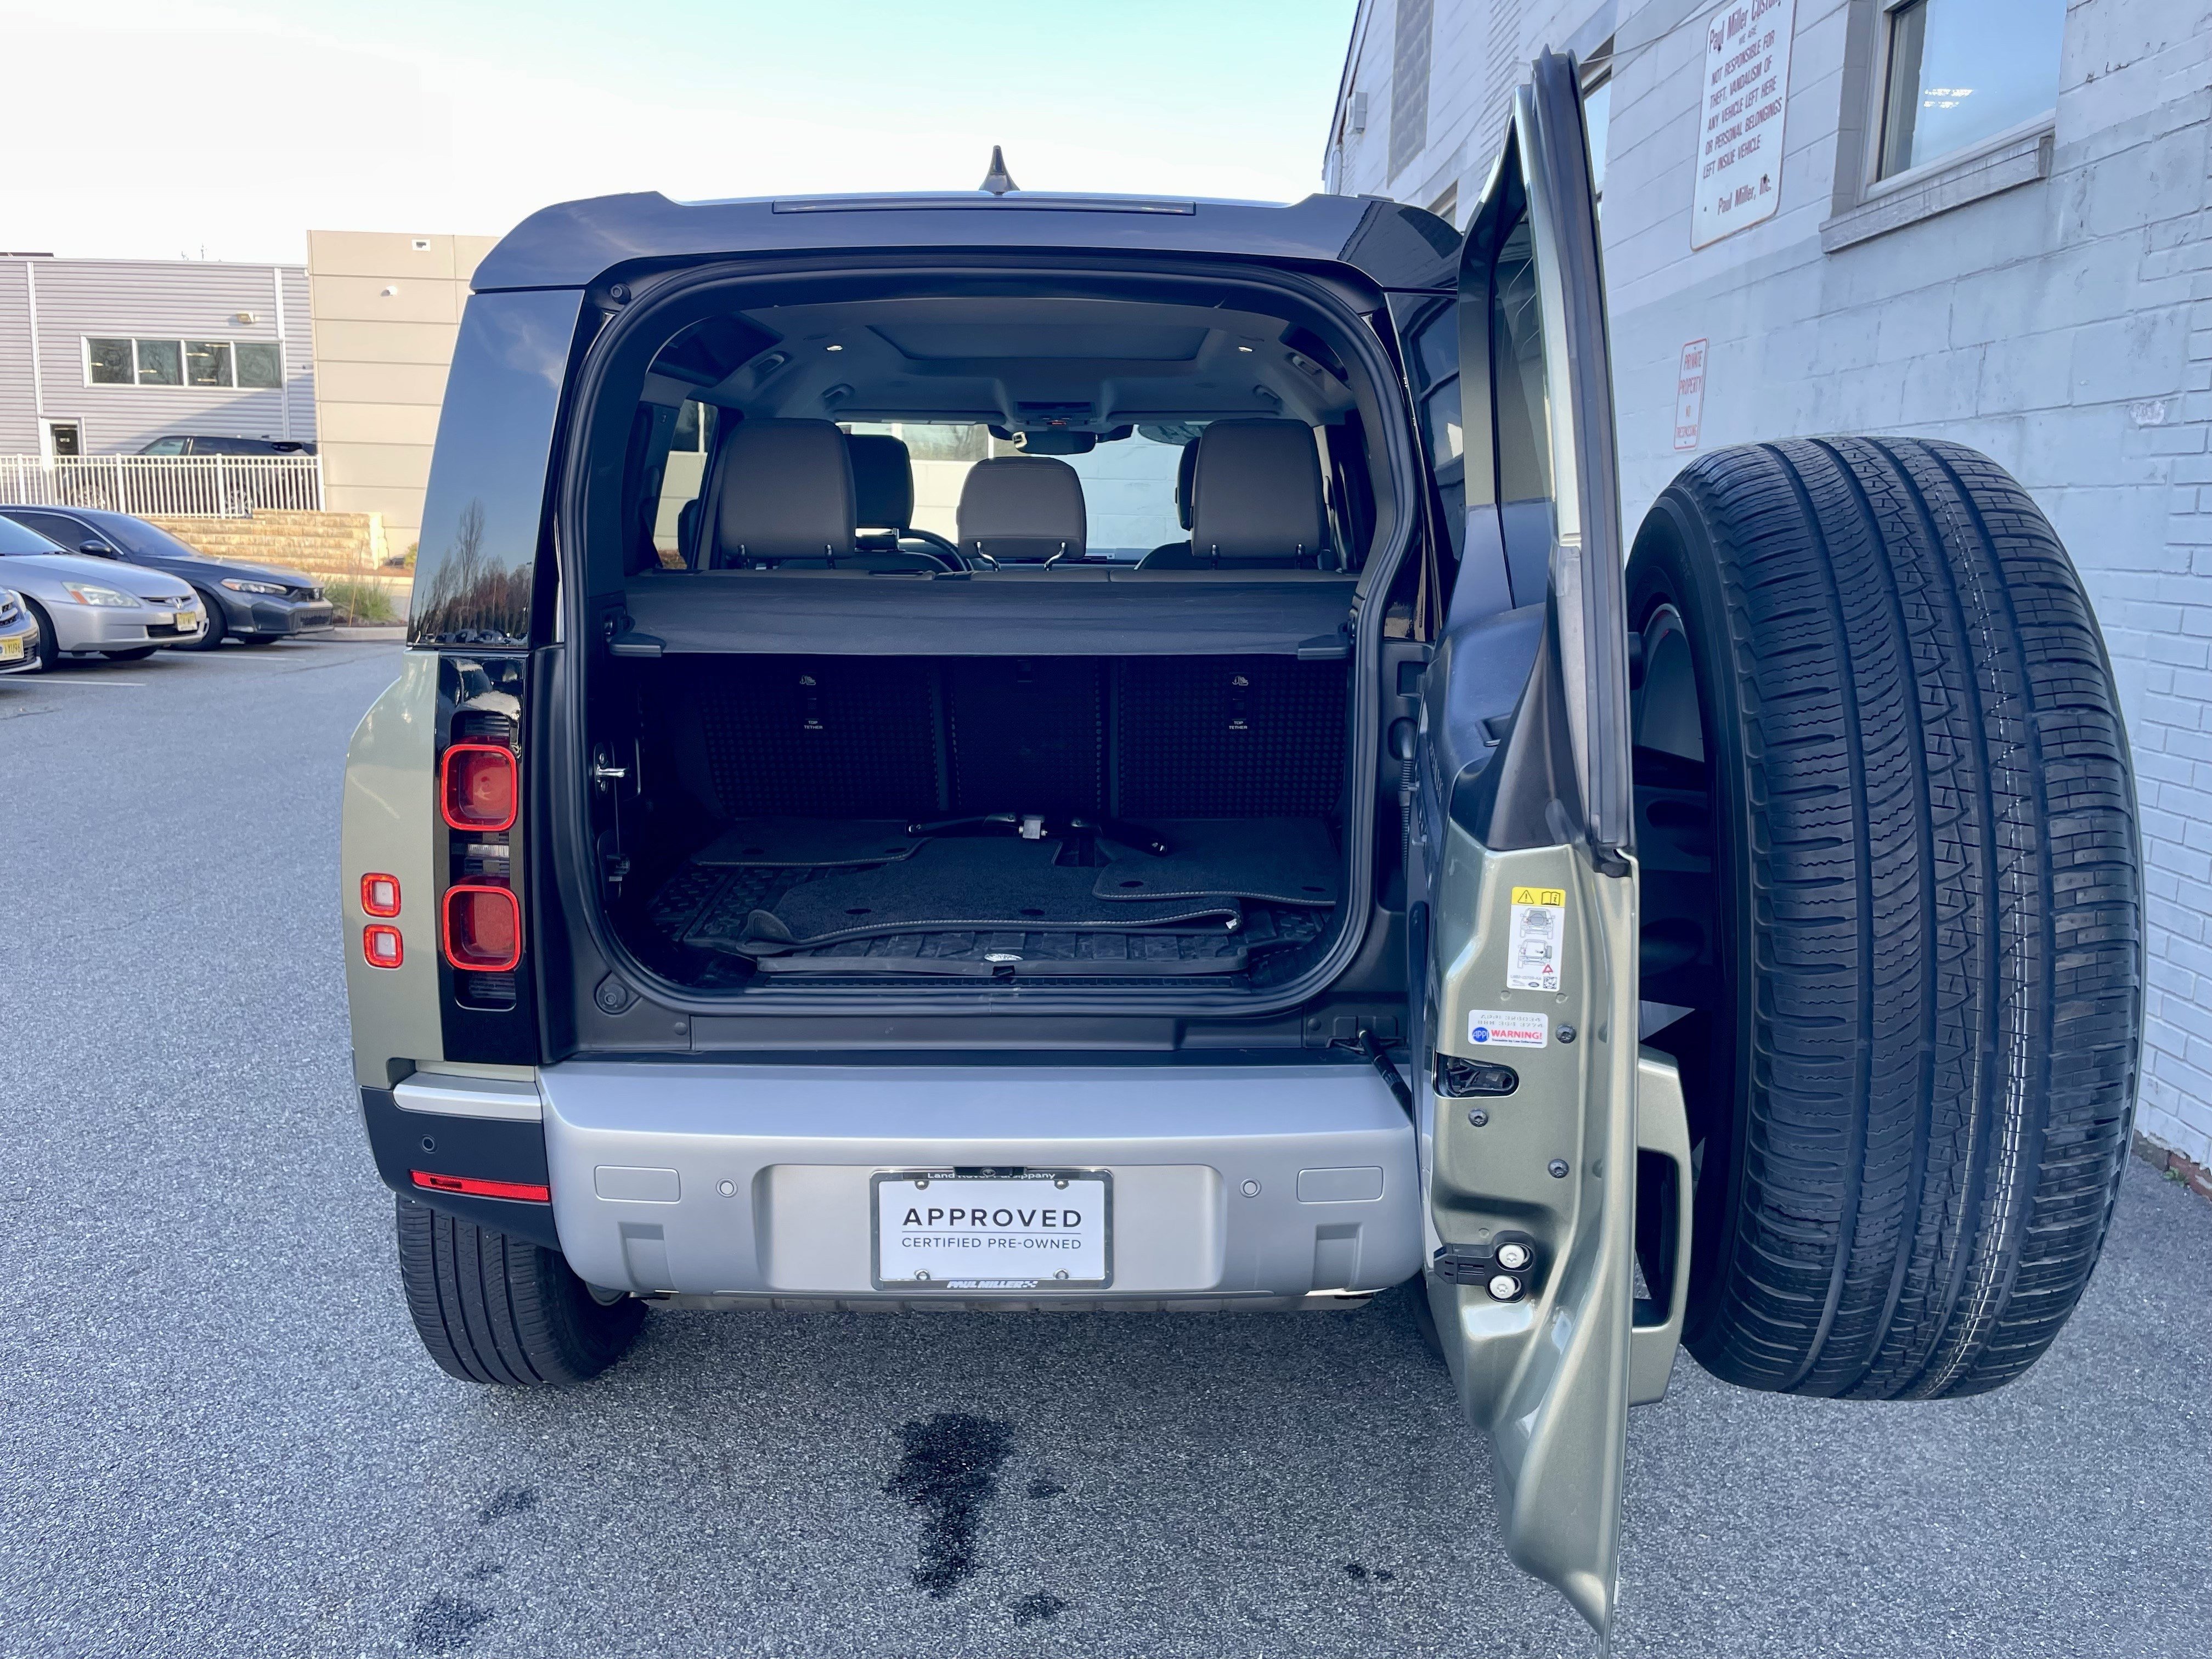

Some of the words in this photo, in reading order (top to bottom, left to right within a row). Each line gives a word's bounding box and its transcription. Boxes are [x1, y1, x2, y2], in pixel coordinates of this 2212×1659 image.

[1709, 20, 1725, 54] Paul
[1727, 7, 1748, 40] Miller
[1712, 66, 1723, 86] NOT
[1724, 39, 1761, 77] RESPONSIBLE
[1763, 30, 1775, 50] FOR
[1730, 61, 1762, 96] VANDALISM
[1707, 112, 1719, 133] ANY
[1722, 98, 1743, 123] VEHICLE
[1745, 87, 1759, 109] LEFT
[1760, 75, 1777, 98] HERE
[1705, 139, 1713, 156] OR
[1715, 122, 1742, 151] PERSONAL
[1745, 97, 1782, 132] BELONGINGS
[1703, 160, 1716, 179] LEFT
[1738, 134, 1761, 160] VEHICLE
[1718, 192, 1733, 216] Paul
[1472, 1030, 1488, 1039] APPI
[1491, 1029, 1543, 1040] WARNING!
[903, 1208, 1081, 1227] APPROVED
[901, 1238, 981, 1248] CERTIFIED
[988, 1238, 1081, 1249] PRE-OWNED
